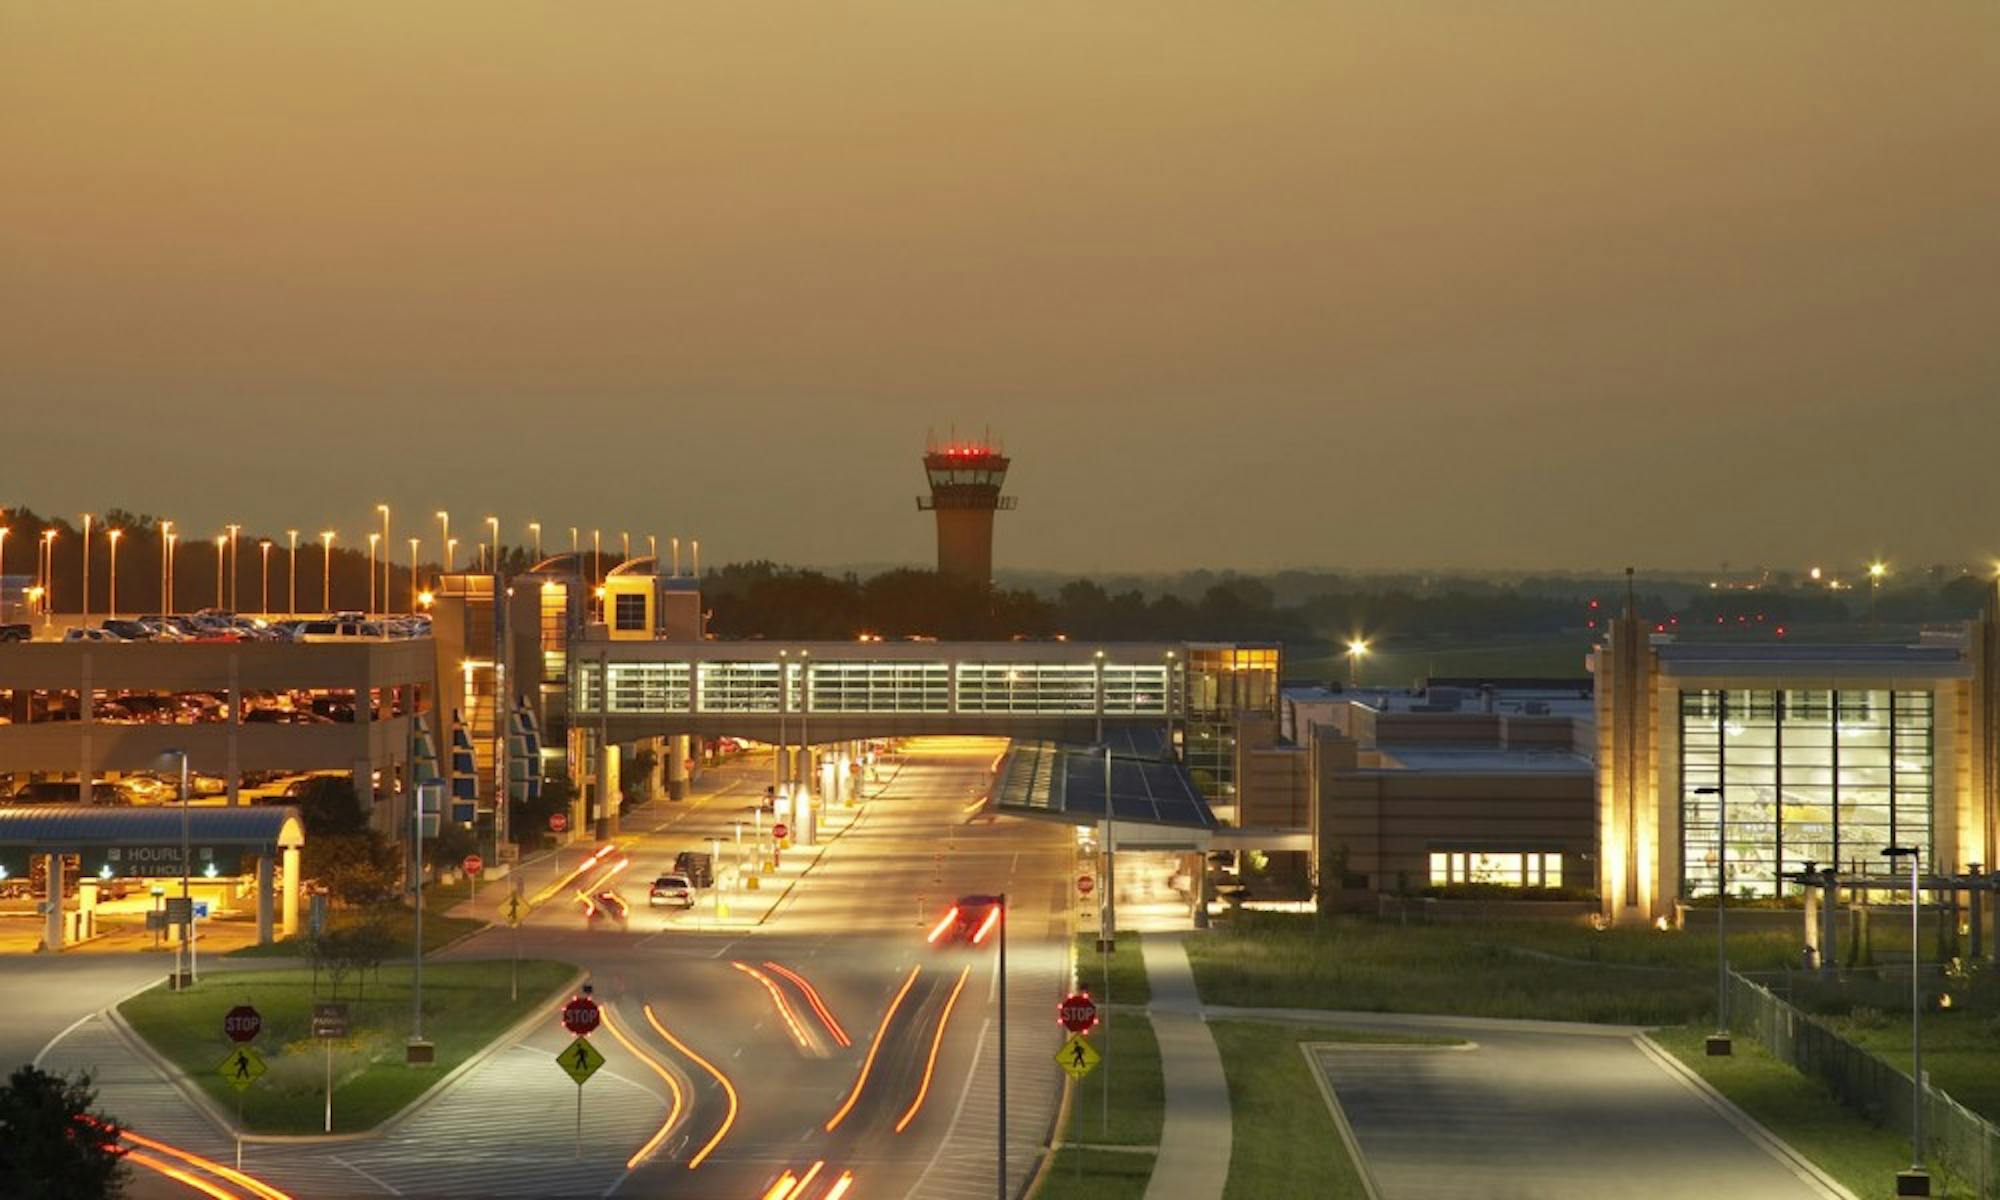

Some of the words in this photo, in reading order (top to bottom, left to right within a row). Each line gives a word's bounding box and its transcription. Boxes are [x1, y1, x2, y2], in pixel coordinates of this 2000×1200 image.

[129, 847, 192, 861] HOURLY
[566, 1008, 598, 1024] STOP
[1063, 1007, 1094, 1021] STOP
[227, 1017, 260, 1032] STOP
